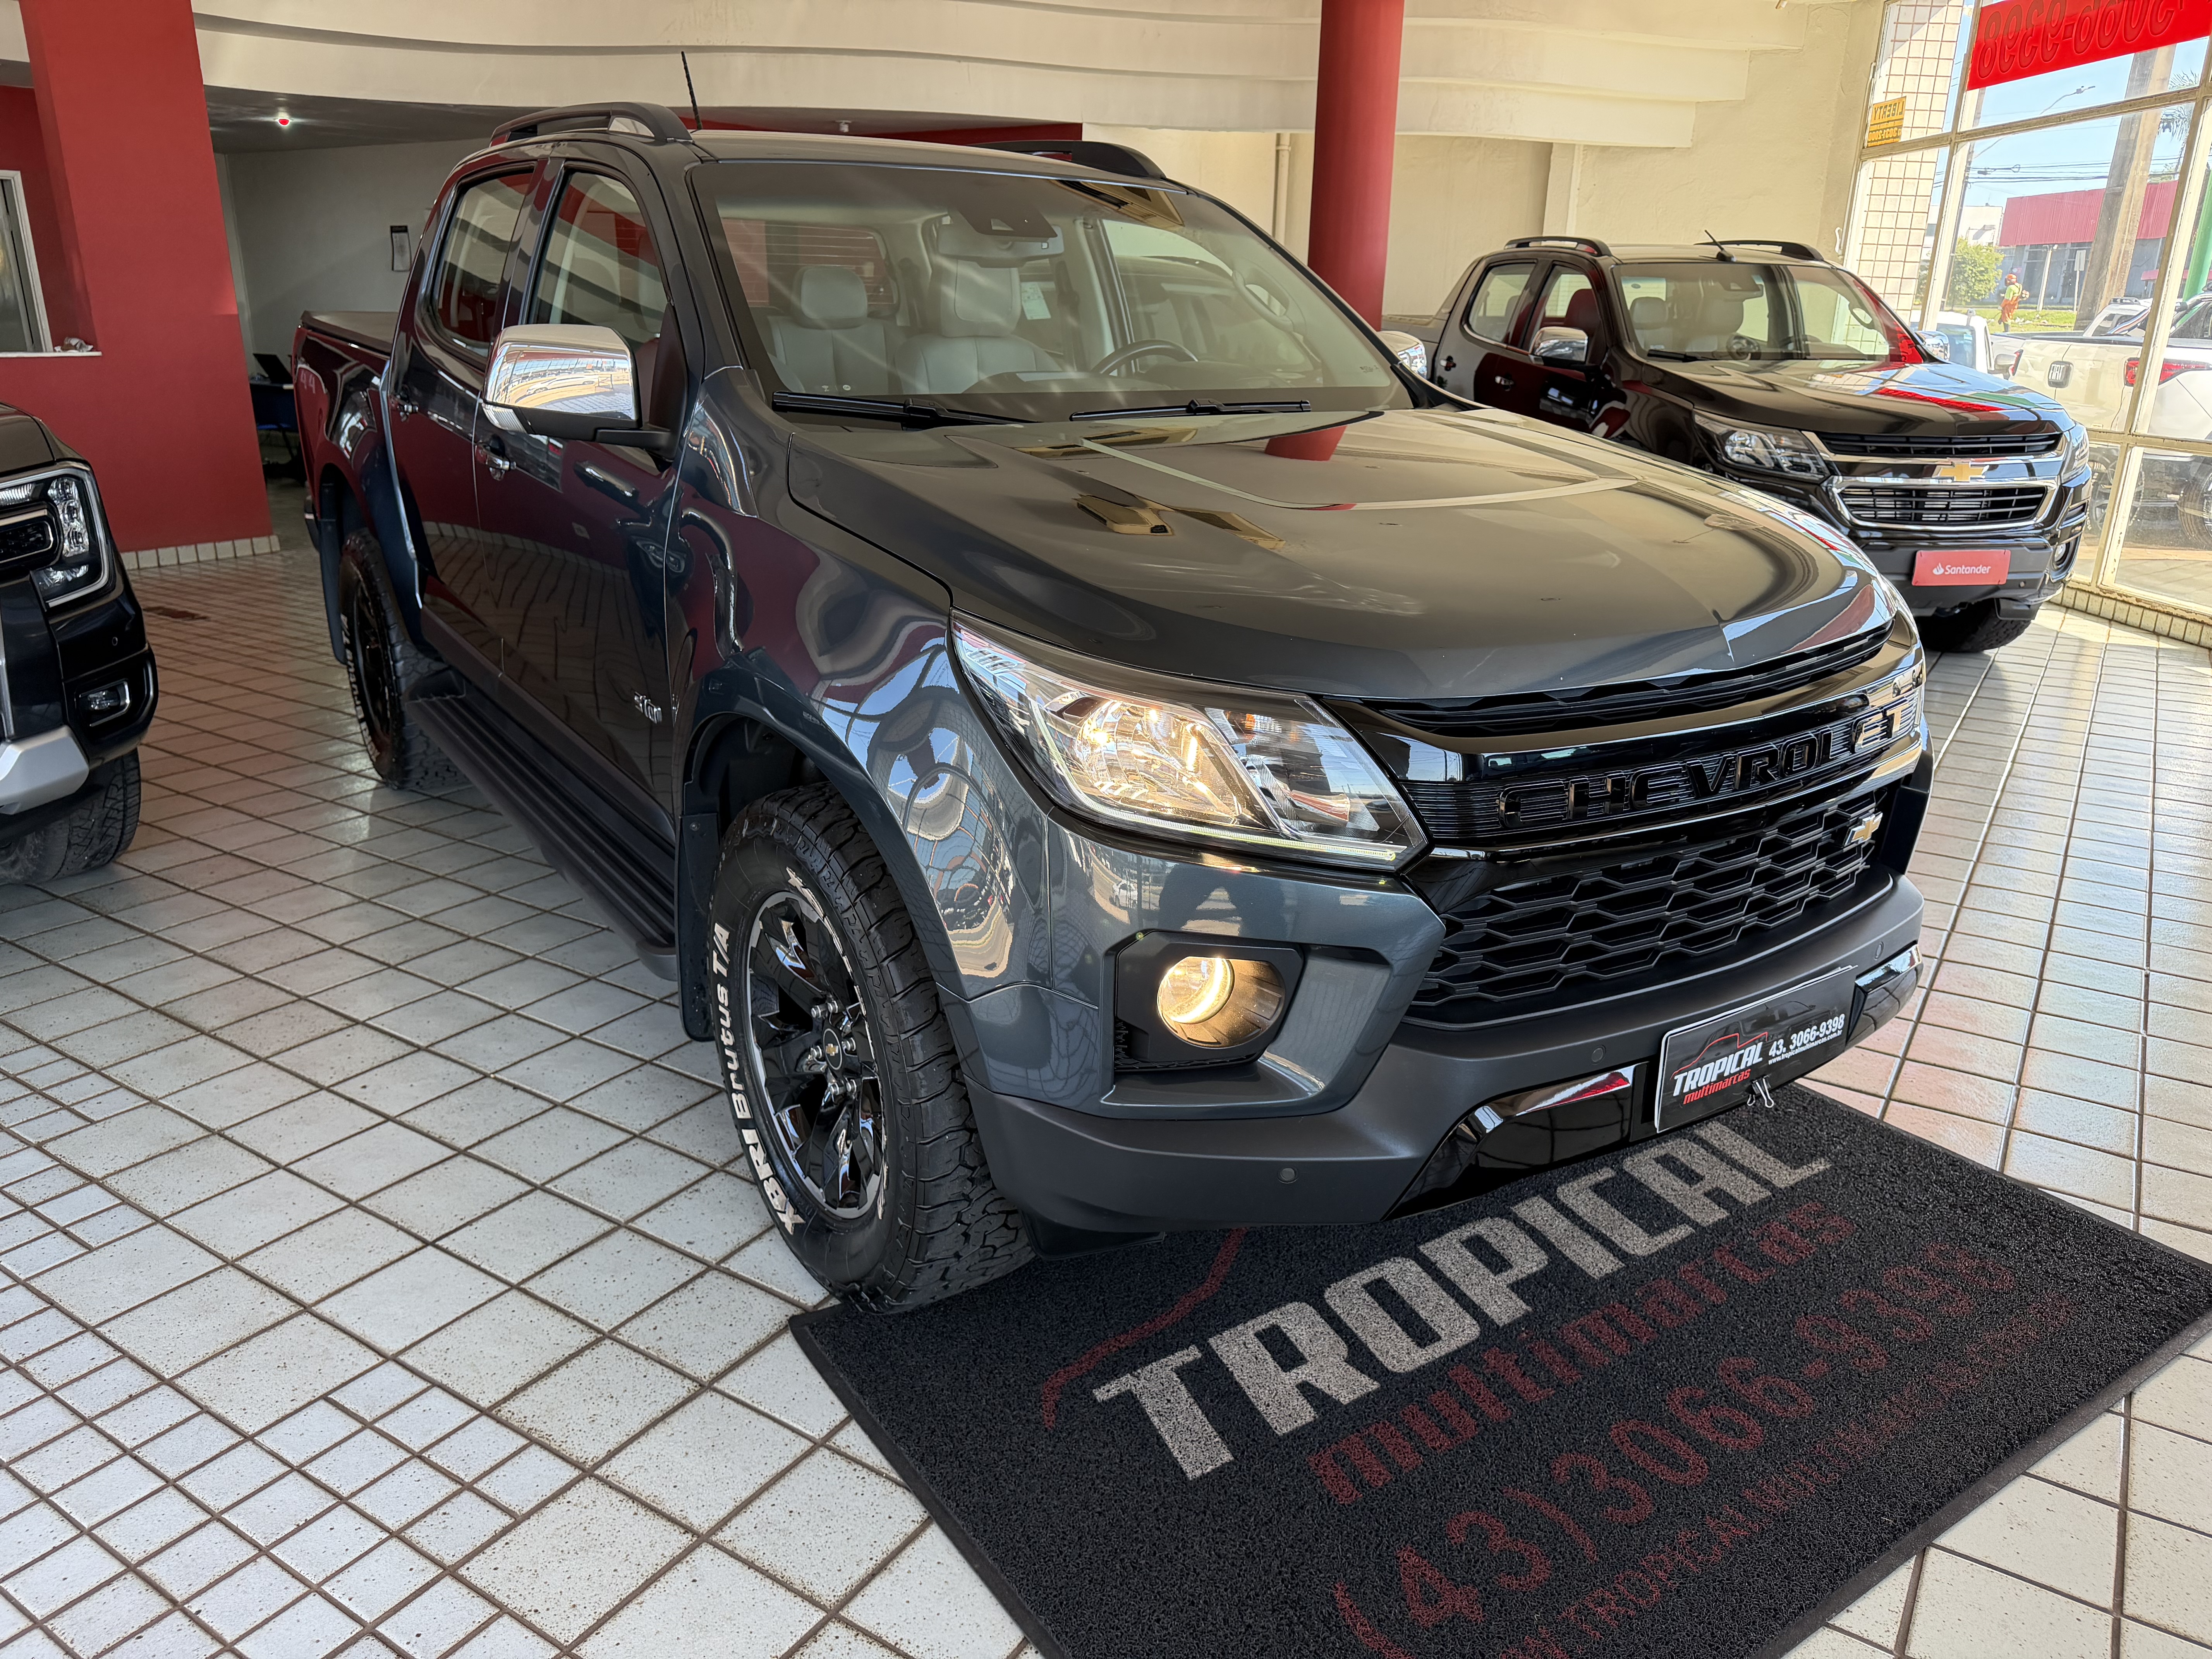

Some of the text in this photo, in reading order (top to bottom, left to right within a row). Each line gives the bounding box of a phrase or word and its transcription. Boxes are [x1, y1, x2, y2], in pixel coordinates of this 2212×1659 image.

[2048, 364, 2065, 380] FIAT
[1945, 565, 1991, 575] Santander
[1499, 697, 1909, 828] CHEVROLET
[1768, 1030, 1843, 1065] www.tropicalmultimarcas.com.br
[1789, 1014, 1845, 1049] 3066-9398
[713, 922, 806, 1235] XBRI Brutus T/A
[1673, 1042, 1763, 1096] TROPICAL
[1683, 1069, 1751, 1104] multimarcas
[1092, 1120, 1832, 1480] TROPICAL
[1308, 1202, 1856, 1504] multimarcas
